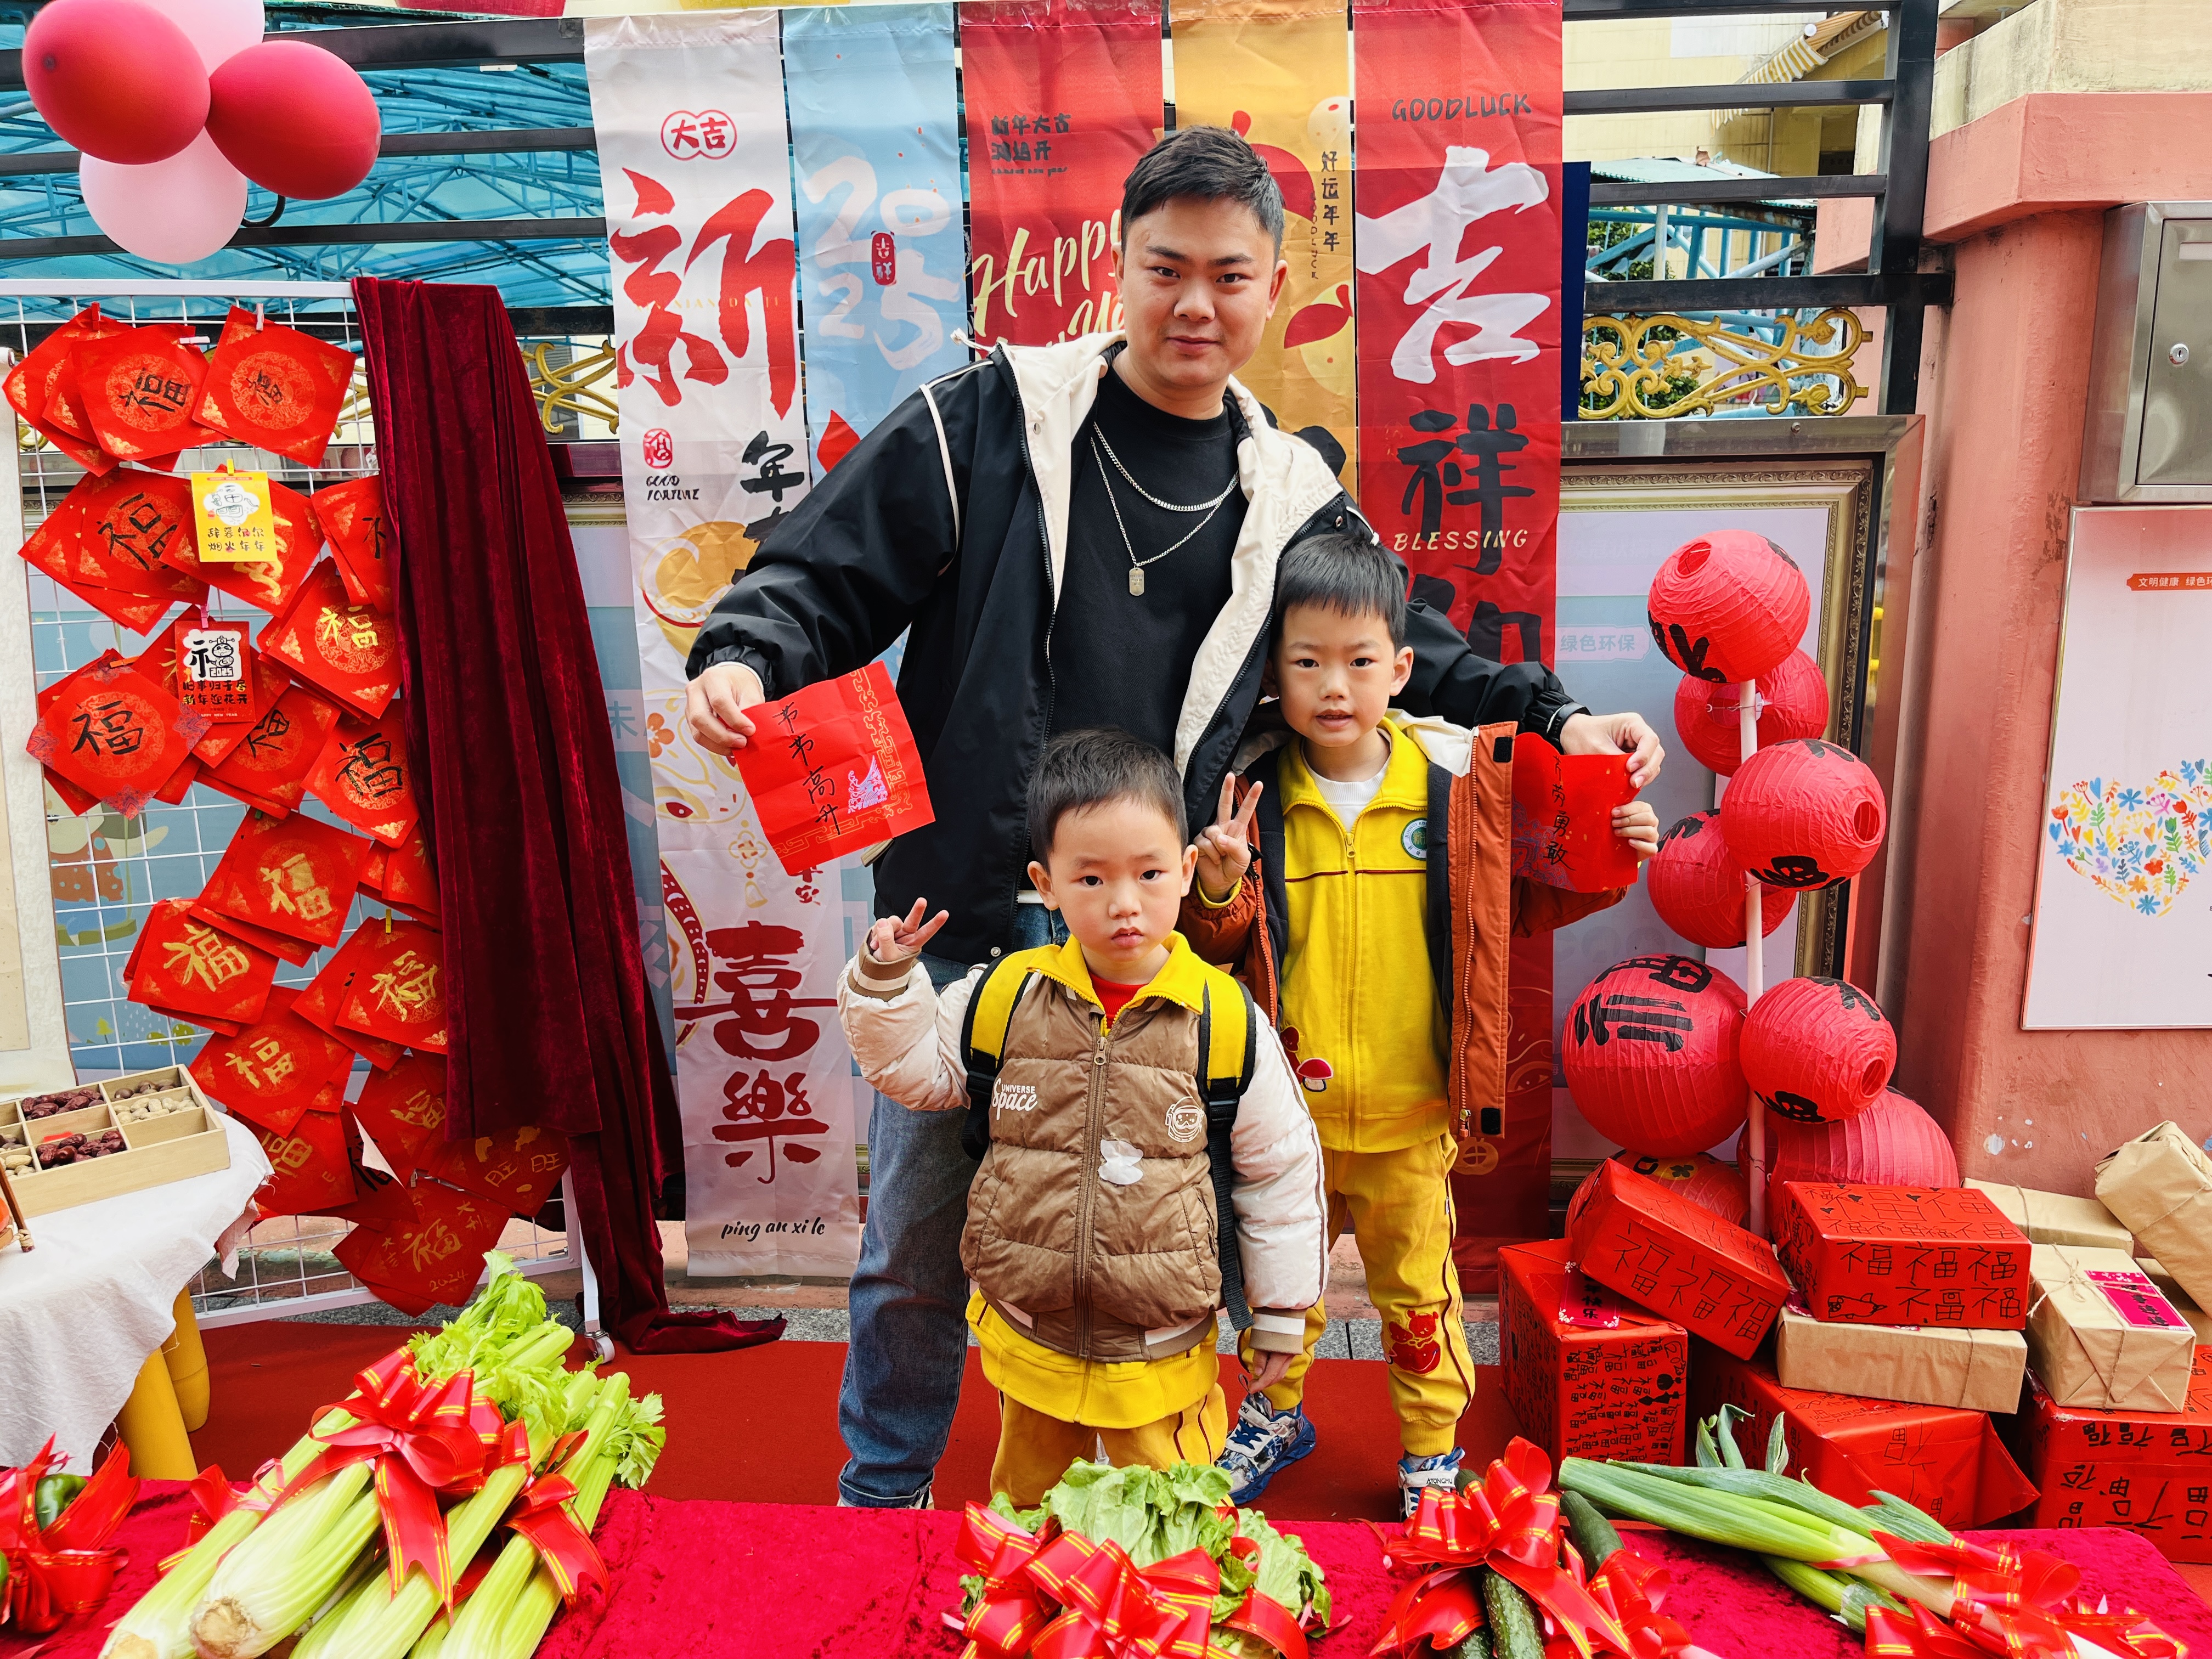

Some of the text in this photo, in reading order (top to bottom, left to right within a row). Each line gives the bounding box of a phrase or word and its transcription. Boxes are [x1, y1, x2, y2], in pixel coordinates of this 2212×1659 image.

[1392, 93, 1531, 121] GOODLUCK
[670, 117, 727, 150] 大吉
[1322, 151, 1339, 251] 好运年年
[119, 366, 189, 416] 福
[1393, 530, 1528, 551] BLESSING
[2138, 577, 2180, 587] 文明健康
[1560, 634, 1635, 652] 绿色环保
[72, 701, 143, 756] 福
[772, 702, 840, 835] 节节高升
[261, 853, 332, 920] 福
[162, 923, 249, 992] 福
[225, 1036, 296, 1089] 福
[992, 1078, 1038, 1121] Space
[1001, 1084, 1036, 1094] UNIVERSE
[721, 1220, 759, 1242] ping
